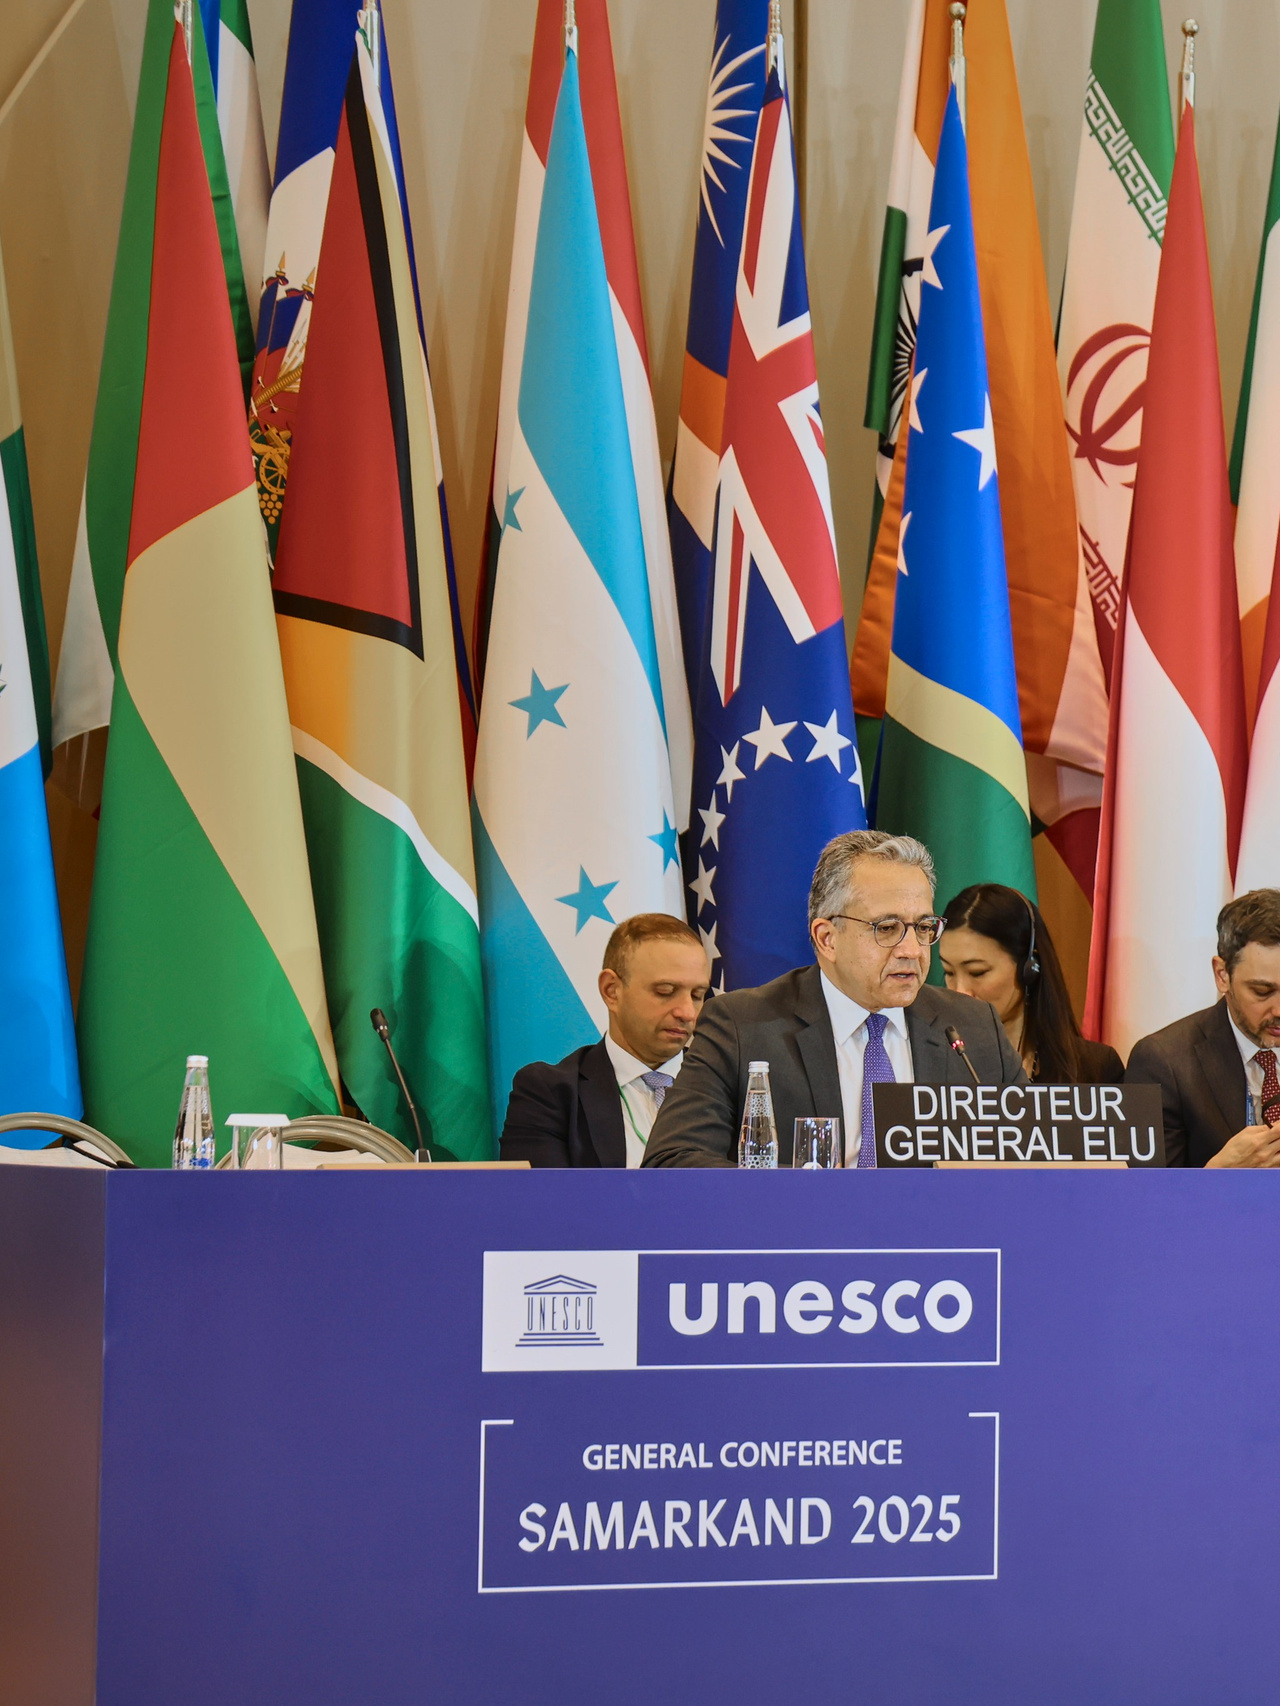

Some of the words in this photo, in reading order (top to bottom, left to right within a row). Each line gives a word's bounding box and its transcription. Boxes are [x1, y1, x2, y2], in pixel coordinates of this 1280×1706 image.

[912, 1085, 1126, 1121] DIRECTEUR
[884, 1125, 1073, 1161] GENERAL
[1082, 1126, 1156, 1161] ELU
[527, 1296, 594, 1331] UNESCO
[669, 1279, 973, 1335] unesco
[582, 1442, 714, 1471] GENERAL
[719, 1439, 903, 1468] CONFERENCE
[518, 1497, 832, 1552] SAMARKAND
[850, 1494, 961, 1544] 2025
